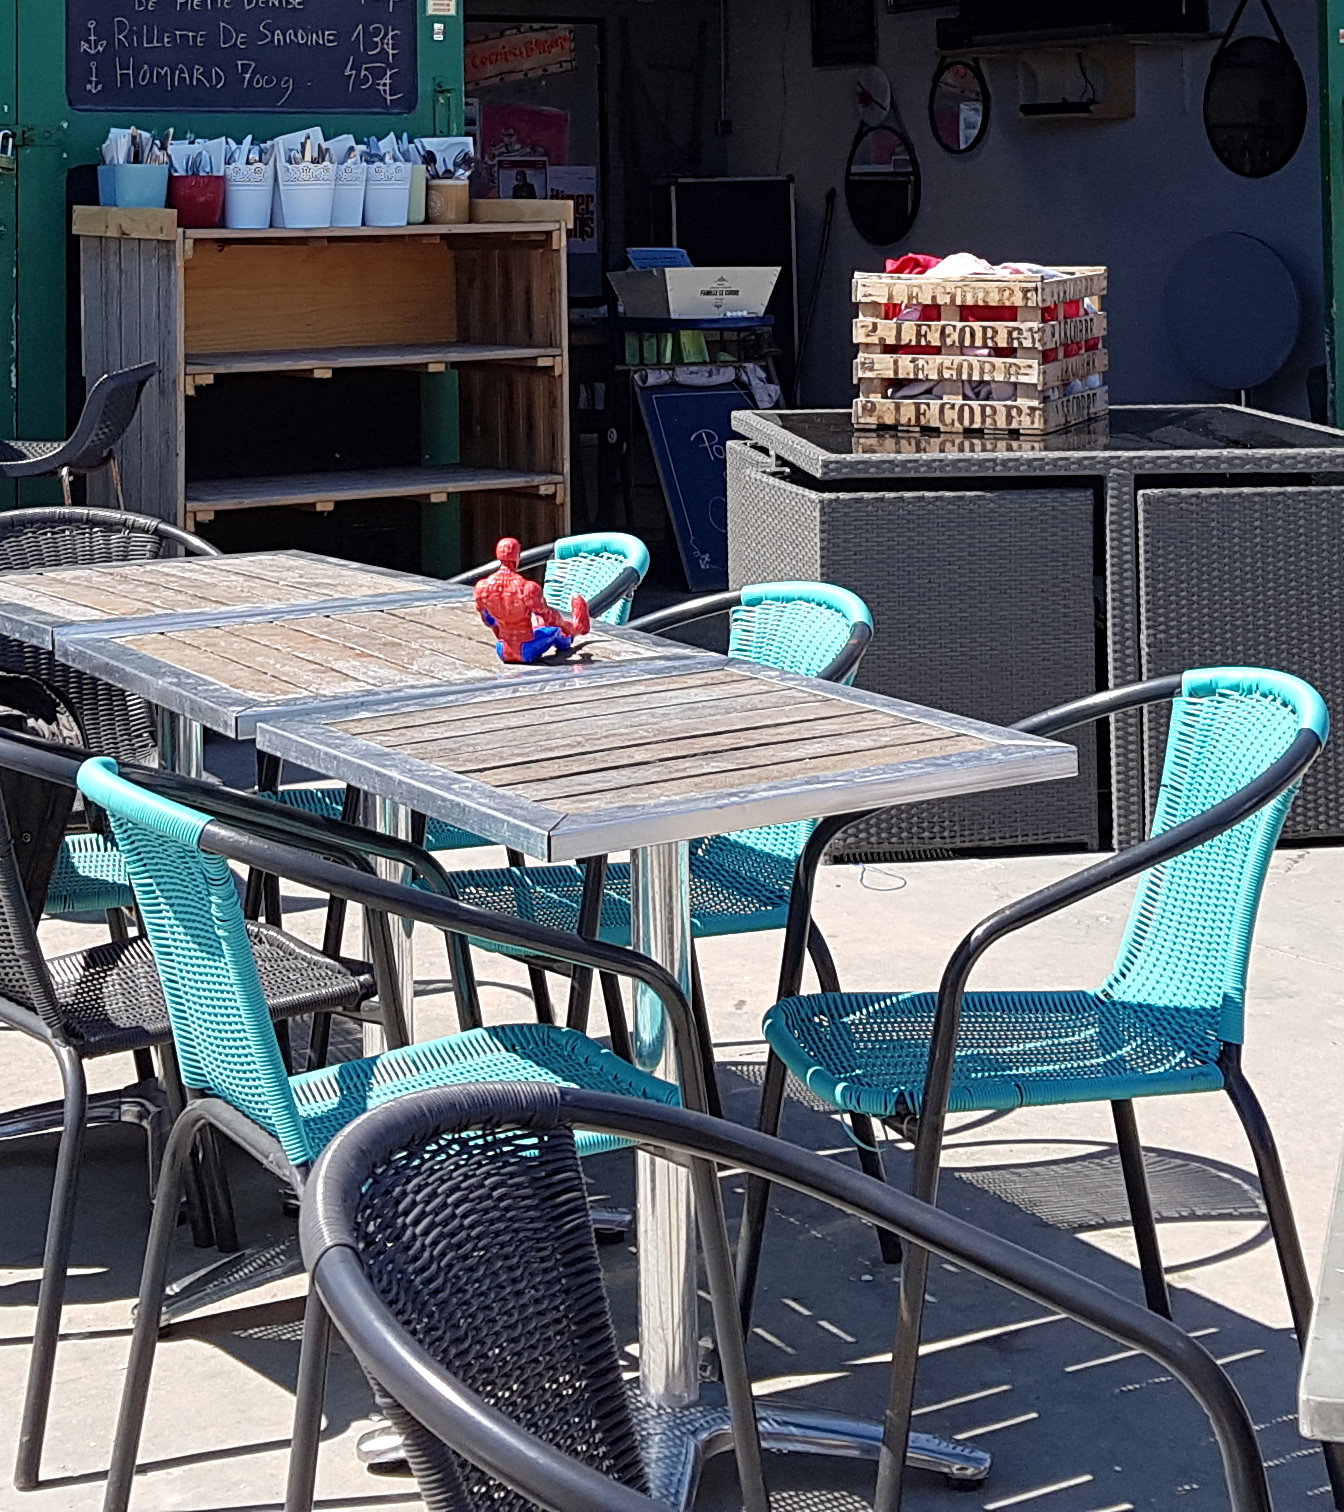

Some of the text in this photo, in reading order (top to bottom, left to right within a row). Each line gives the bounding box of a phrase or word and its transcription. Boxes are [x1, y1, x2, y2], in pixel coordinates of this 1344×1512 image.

[114, 17, 208, 50] RILLETTE
[219, 21, 248, 48] DE
[257, 19, 339, 48] SARDINE
[115, 57, 226, 89] HOMARD
